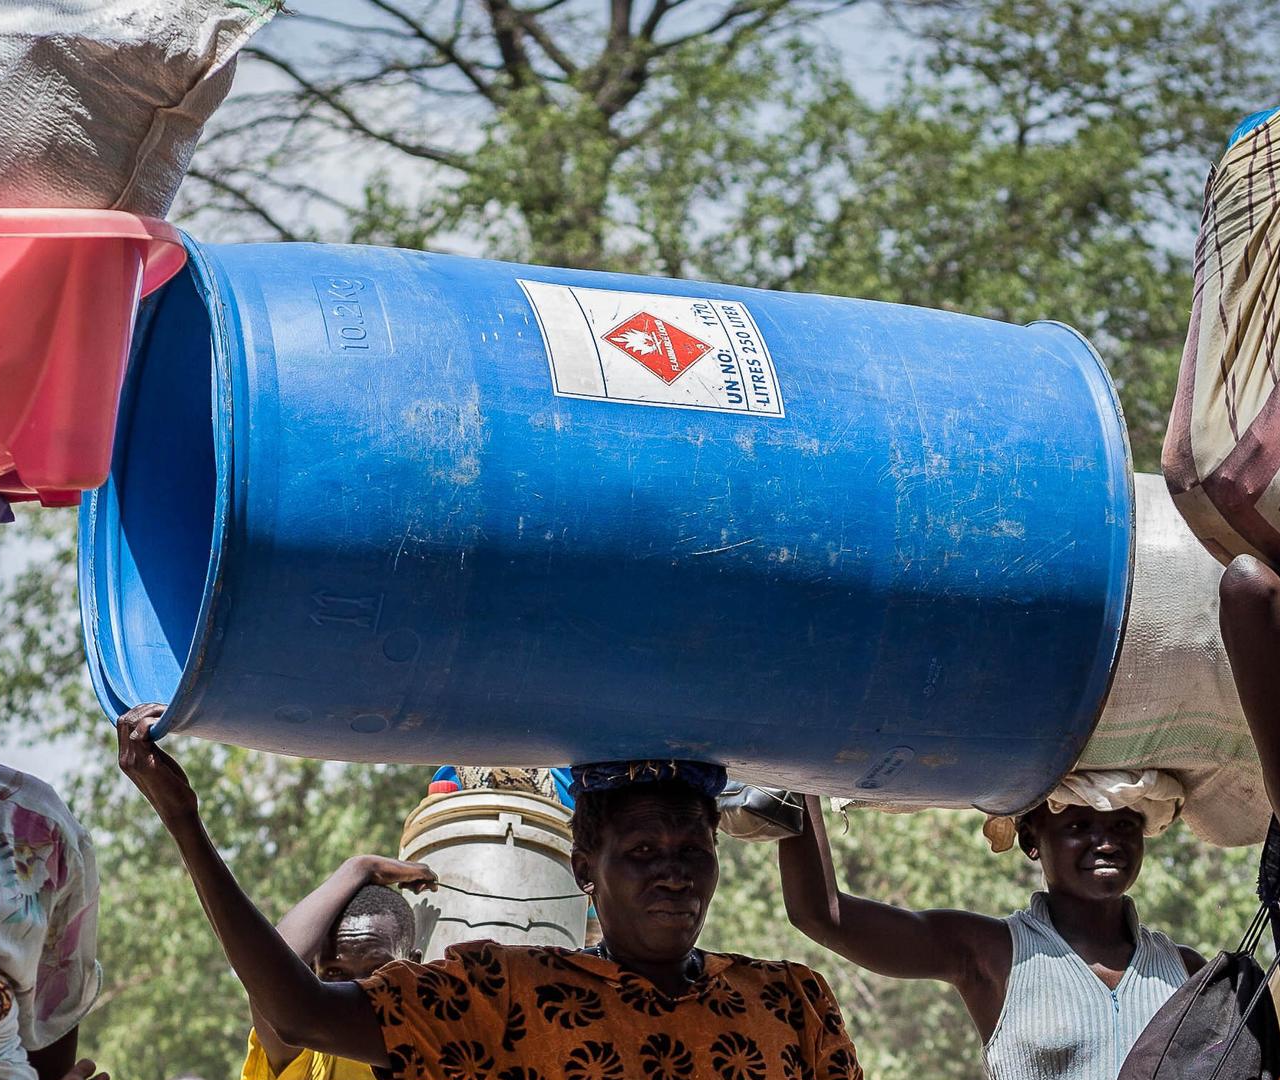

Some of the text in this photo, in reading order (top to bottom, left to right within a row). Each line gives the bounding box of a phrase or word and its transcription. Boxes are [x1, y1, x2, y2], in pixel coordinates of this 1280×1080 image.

[693, 303, 743, 405] UN NO: 1170
[722, 305, 770, 406] LITRES 250 LITER
